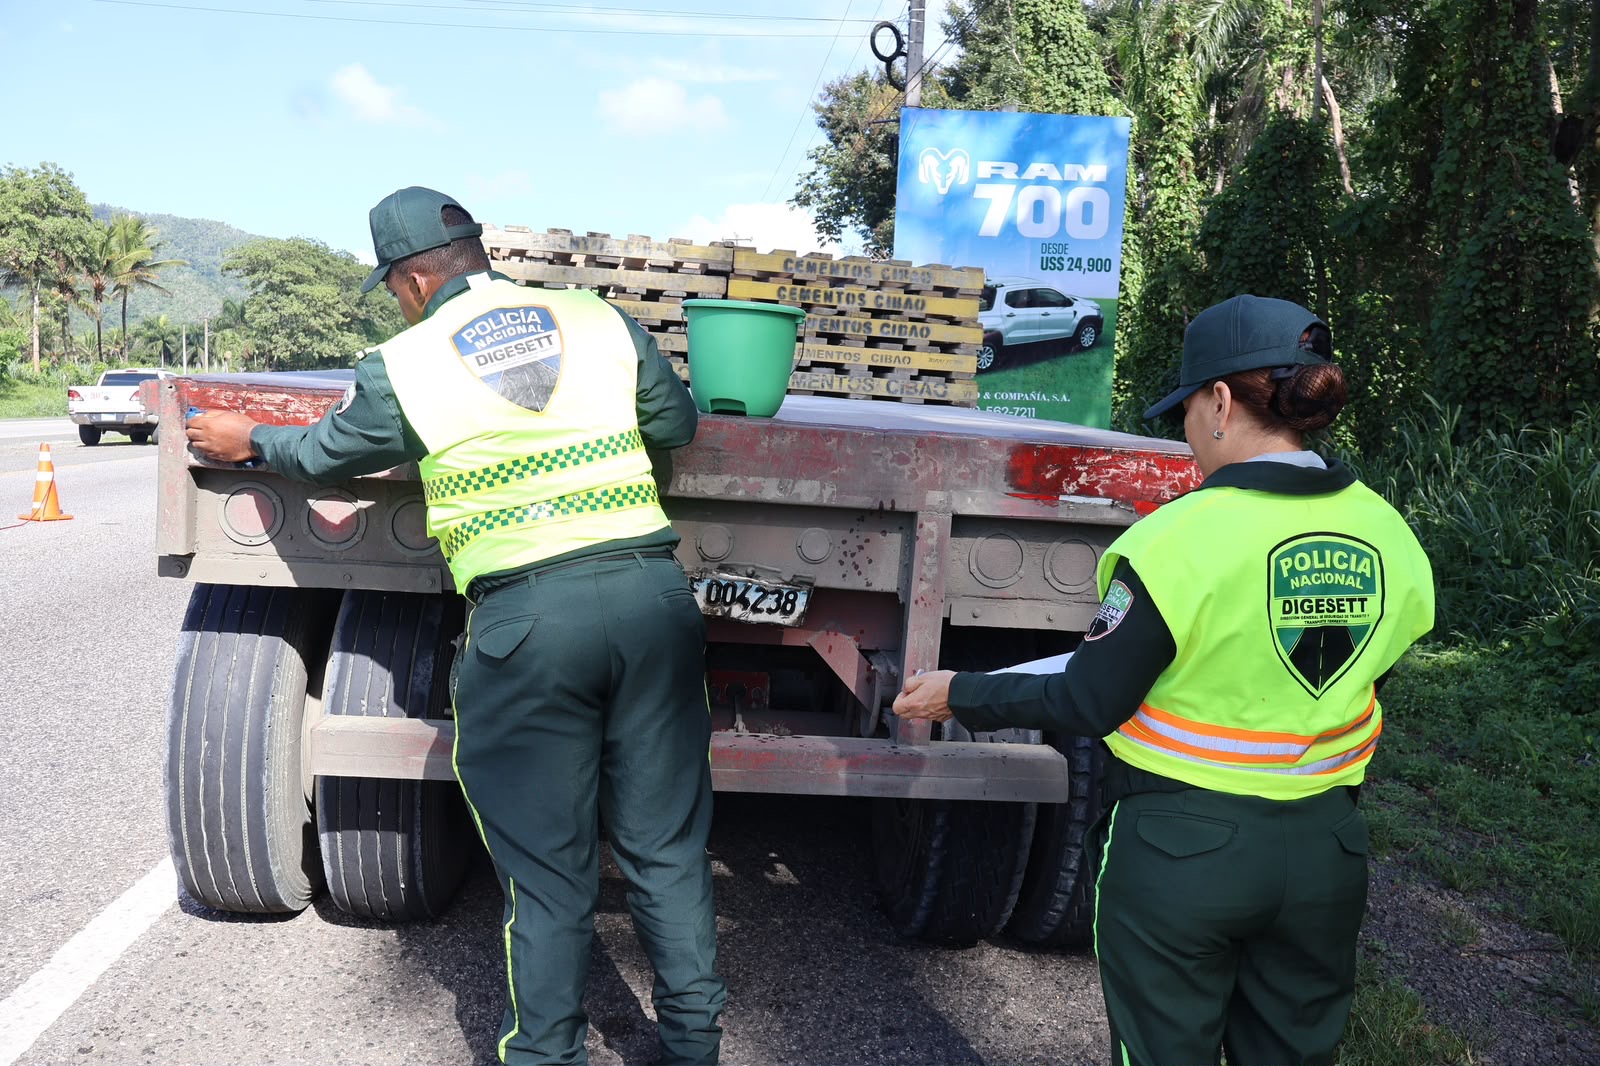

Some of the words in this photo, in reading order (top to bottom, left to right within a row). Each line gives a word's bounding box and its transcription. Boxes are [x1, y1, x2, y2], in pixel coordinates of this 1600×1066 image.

[976, 160, 1108, 182] RAM
[973, 183, 1111, 240] 700
[1040, 243, 1069, 255] DESDE
[783, 258, 873, 280] CEMENTOS
[1040, 256, 1064, 272] US$
[1066, 257, 1112, 275] 24,900
[777, 285, 866, 307] CEMENTOS
[874, 294, 926, 311] CIBAO
[461, 308, 542, 344] POLICÍA
[879, 322, 931, 339] CIBAO
[473, 324, 545, 351] NACIONAL
[475, 334, 554, 367] DIGESETT
[870, 353, 912, 365] CIBAO
[885, 379, 949, 398] CIBAO
[983, 391, 991, 400] &
[994, 390, 1050, 403] COMPAÑÍA,
[1051, 393, 1071, 402] S.A.
[1279, 549, 1371, 579] POLICIA
[1290, 572, 1364, 590] NACIONAL
[1282, 597, 1368, 615] DIGESETT
